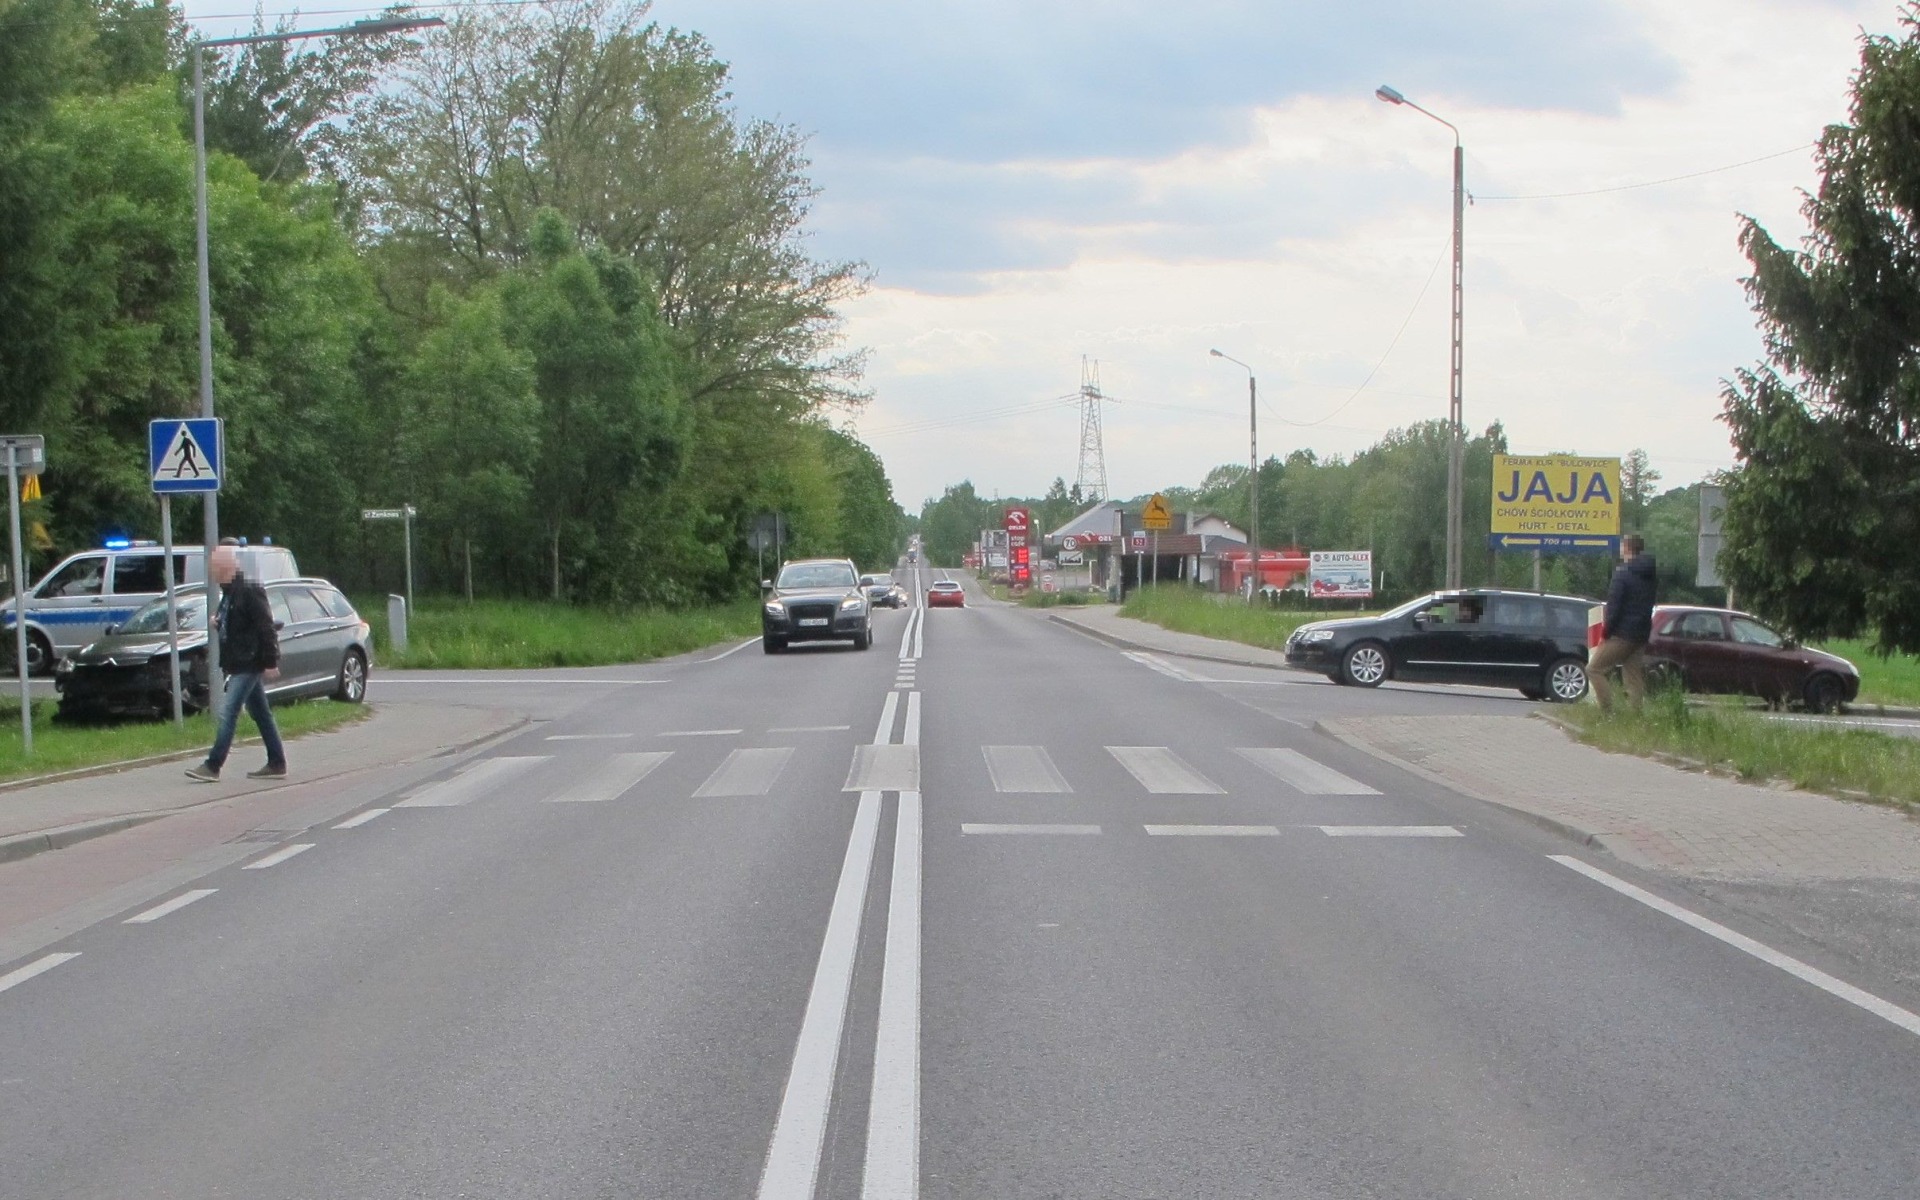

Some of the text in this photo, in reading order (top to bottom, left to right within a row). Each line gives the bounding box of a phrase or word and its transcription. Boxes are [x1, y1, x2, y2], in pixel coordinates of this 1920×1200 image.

[1536, 459, 1553, 467] KUR
[1498, 471, 1613, 504] JAJA
[1518, 521, 1548, 530] HURT
[1556, 522, 1590, 531] DETAL
[1064, 539, 1076, 548] 70
